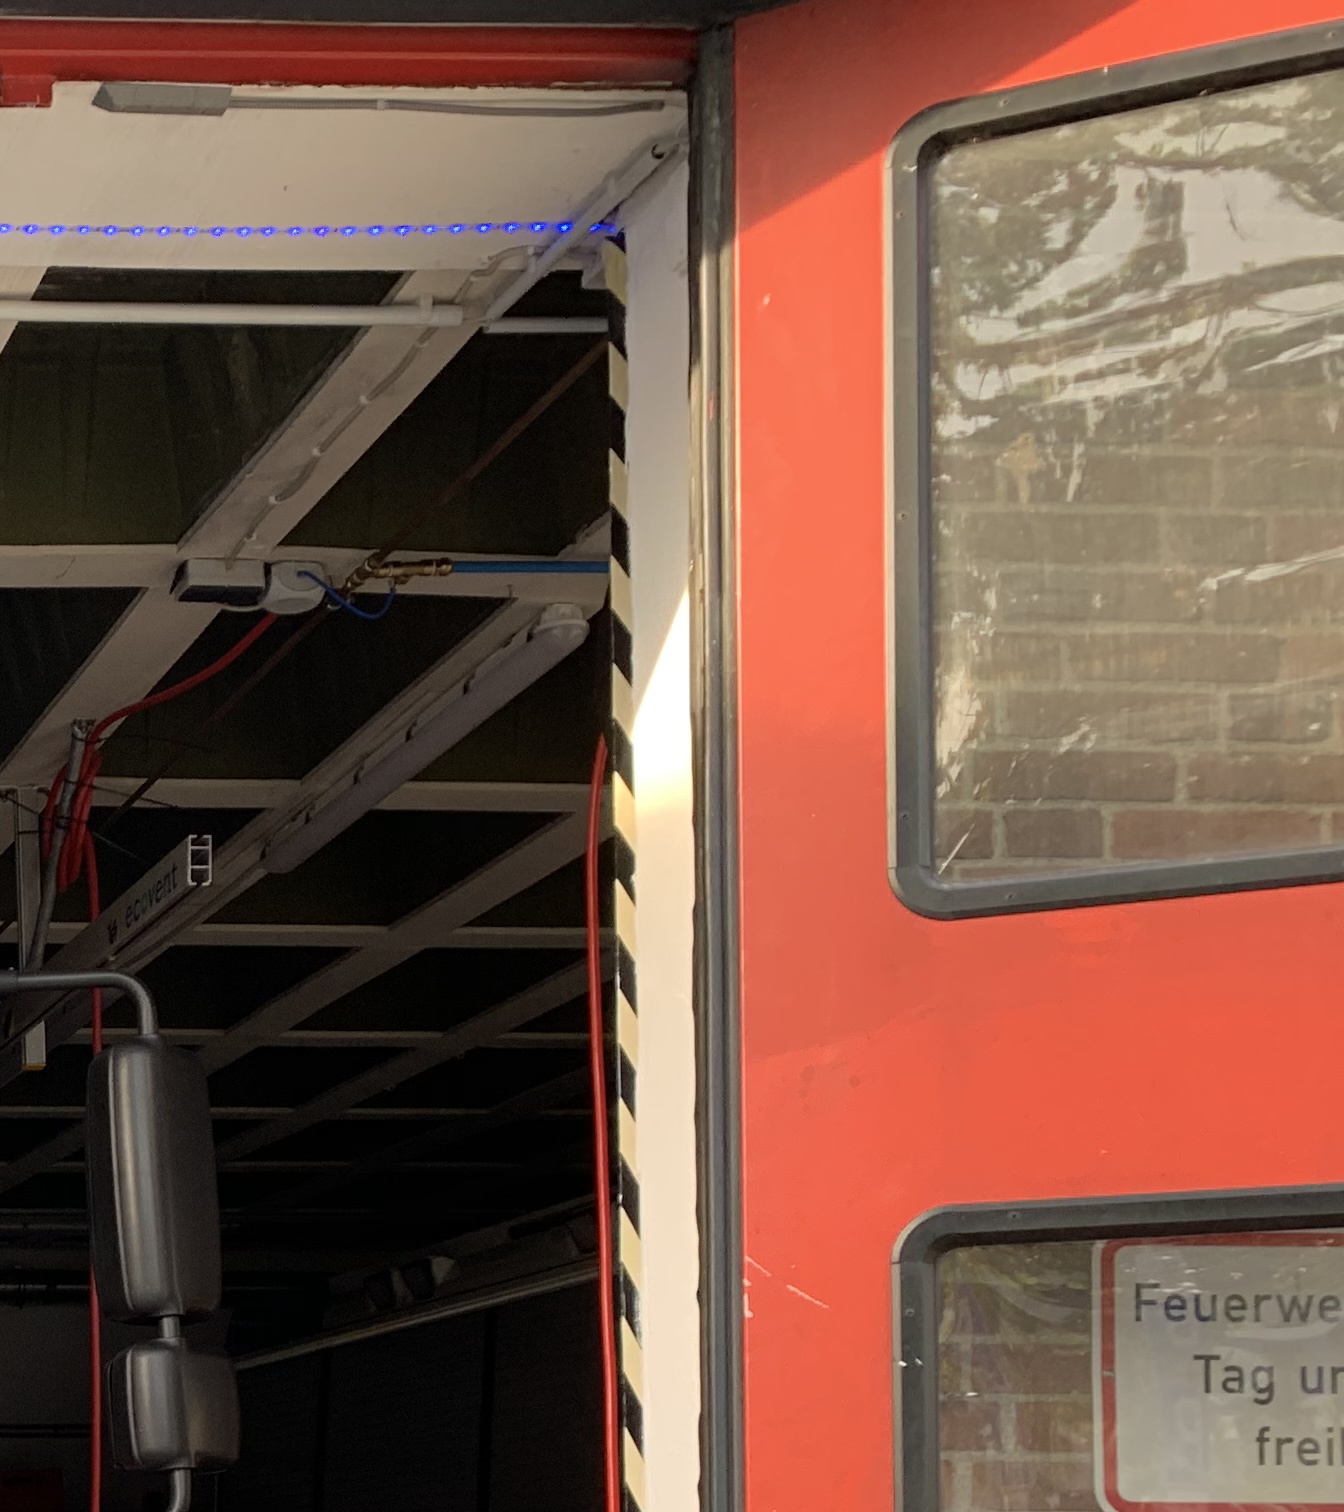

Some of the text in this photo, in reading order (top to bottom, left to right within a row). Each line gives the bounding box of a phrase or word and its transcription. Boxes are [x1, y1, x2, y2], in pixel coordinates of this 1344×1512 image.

[126, 863, 178, 928] ecovent
[1134, 1282, 1341, 1323] Feuerwe
[1193, 1354, 1276, 1406] Tag
[1255, 1426, 1344, 1467] frei
